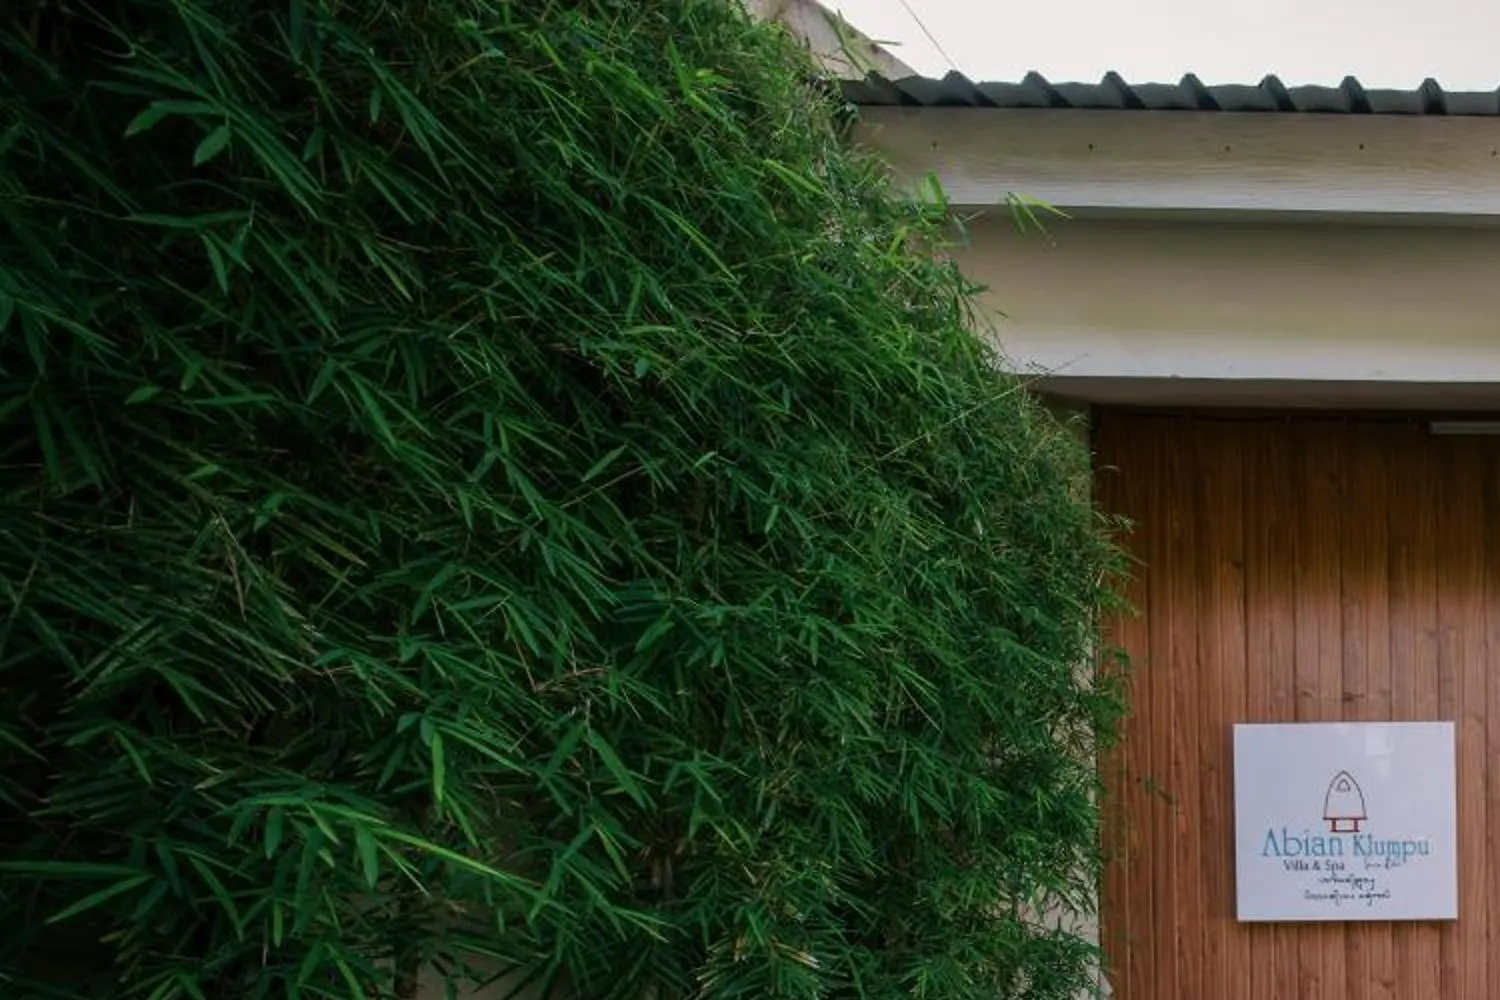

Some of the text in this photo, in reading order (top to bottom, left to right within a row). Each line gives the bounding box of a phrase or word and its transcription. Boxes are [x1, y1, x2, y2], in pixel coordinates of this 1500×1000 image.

[1262, 827, 1430, 863] Abian Klumpu
[1284, 859, 1345, 876] Villa & Spa
